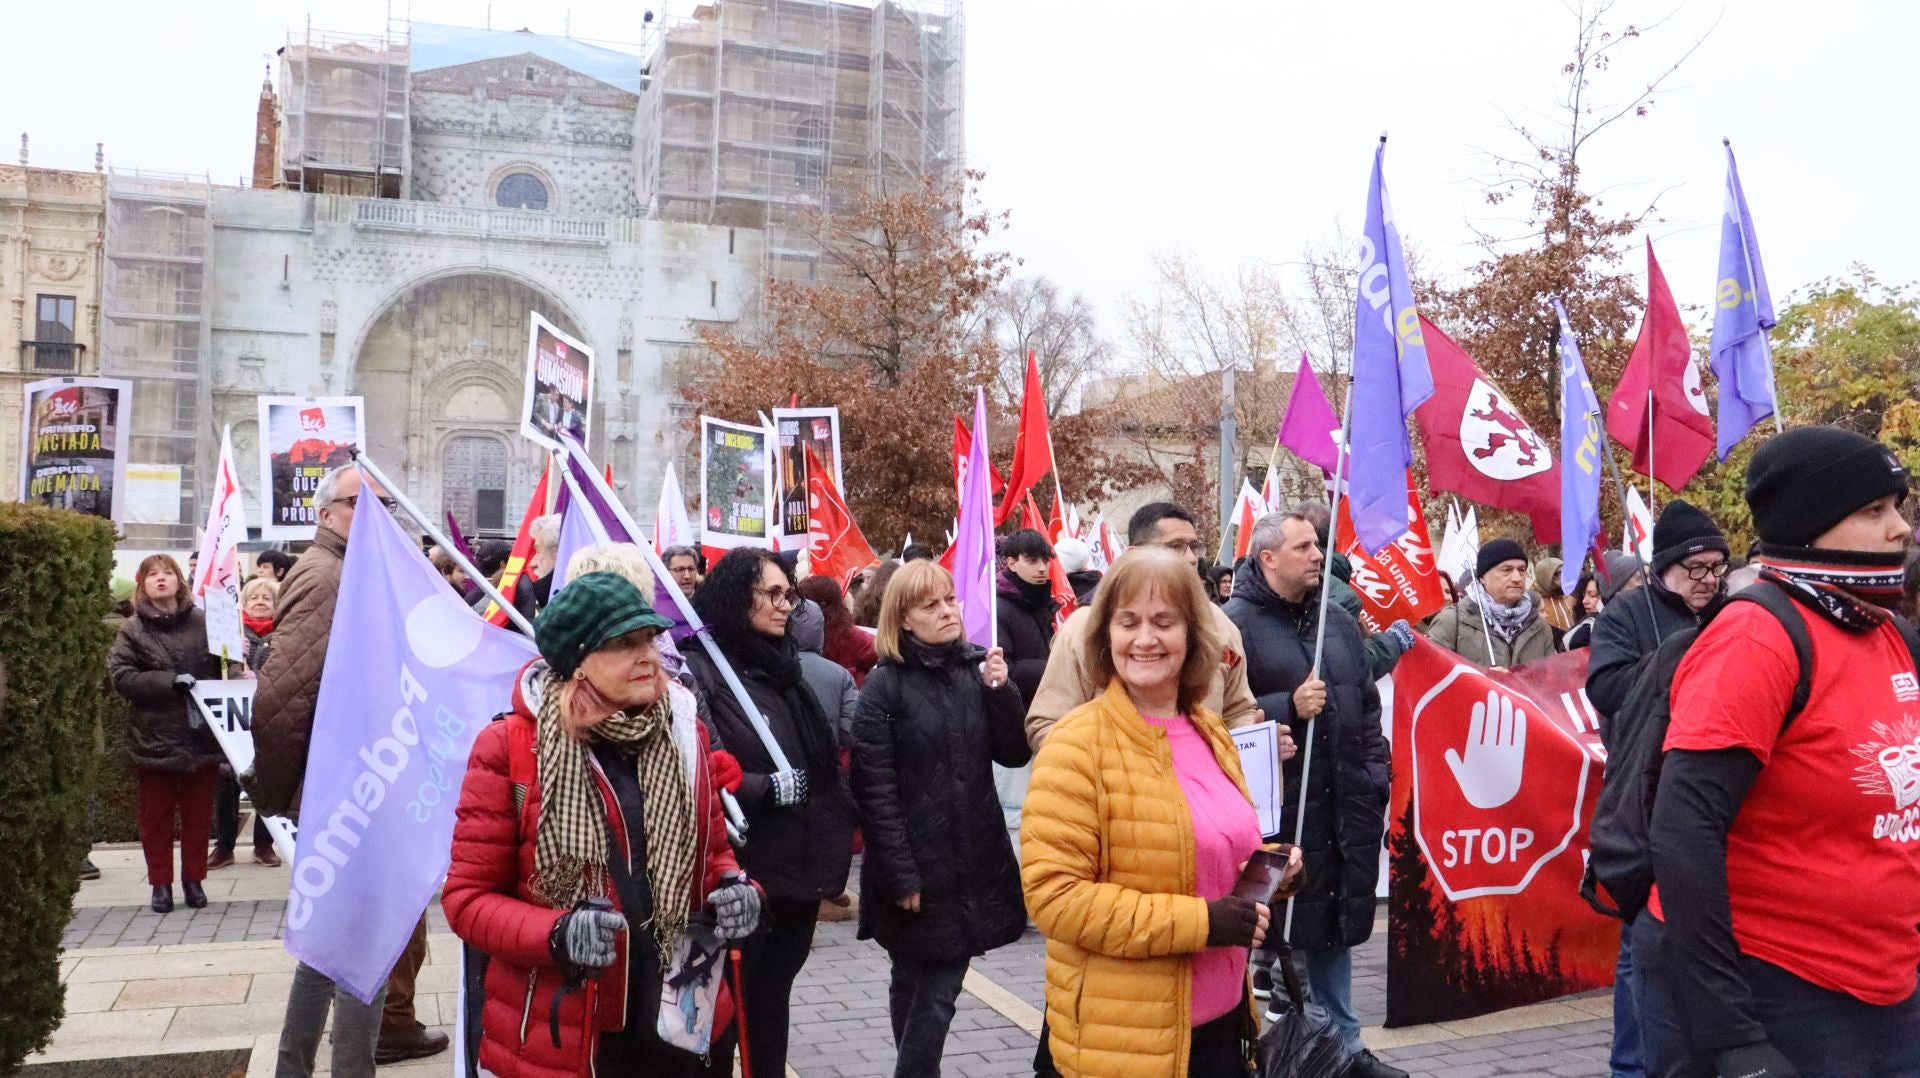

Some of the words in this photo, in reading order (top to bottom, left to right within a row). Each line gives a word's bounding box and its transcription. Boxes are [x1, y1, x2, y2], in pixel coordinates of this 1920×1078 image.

[54, 397, 78, 414] iu
[40, 424, 97, 435] PRIMERO
[302, 415, 322, 431] iu
[813, 424, 829, 439] iu
[35, 432, 101, 453] VACIADA
[295, 467, 302, 477] EL
[31, 473, 100, 498] QUEMADA
[293, 477, 319, 492] QUE
[292, 497, 301, 507] LA
[282, 507, 315, 522] PROB
[1388, 563, 1419, 607] unida
[1442, 827, 1534, 868] STOP
